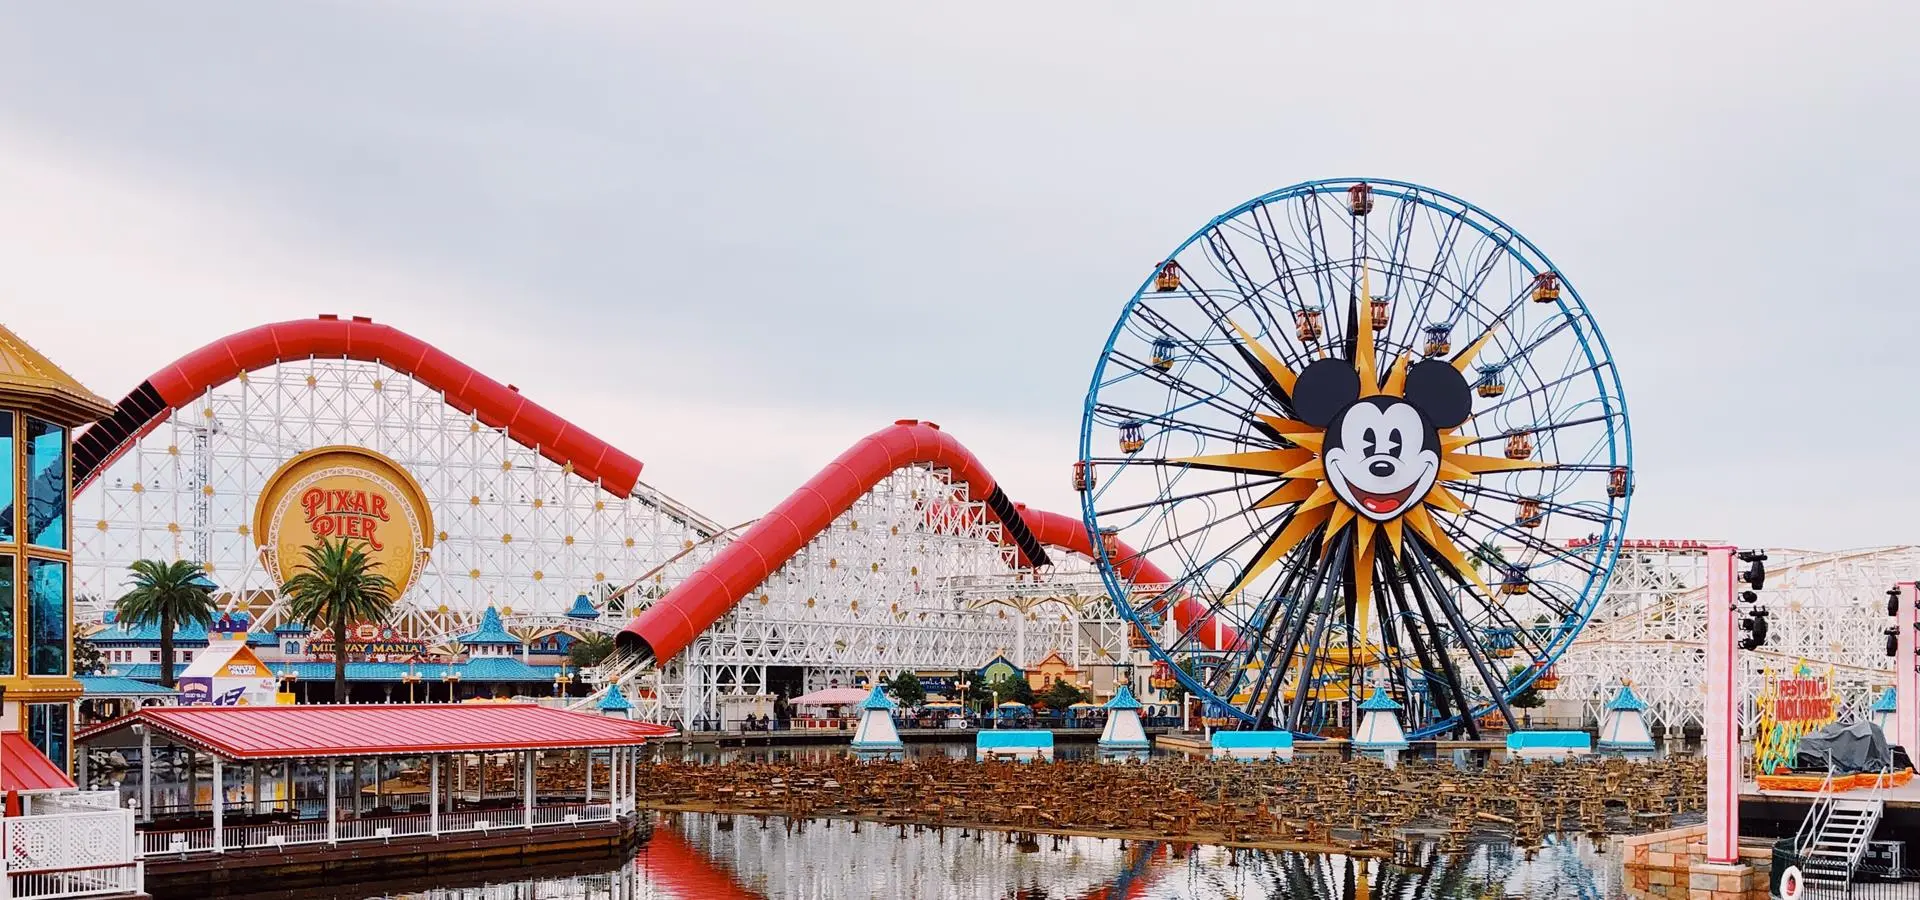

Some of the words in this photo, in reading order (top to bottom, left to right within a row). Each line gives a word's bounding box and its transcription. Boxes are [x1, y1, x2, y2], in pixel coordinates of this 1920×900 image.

[301, 487, 390, 523] PIXAR
[311, 513, 384, 551] PIER
[1779, 679, 1822, 697] FESTIVAL
[1775, 698, 1833, 721] HOLIDAYS
